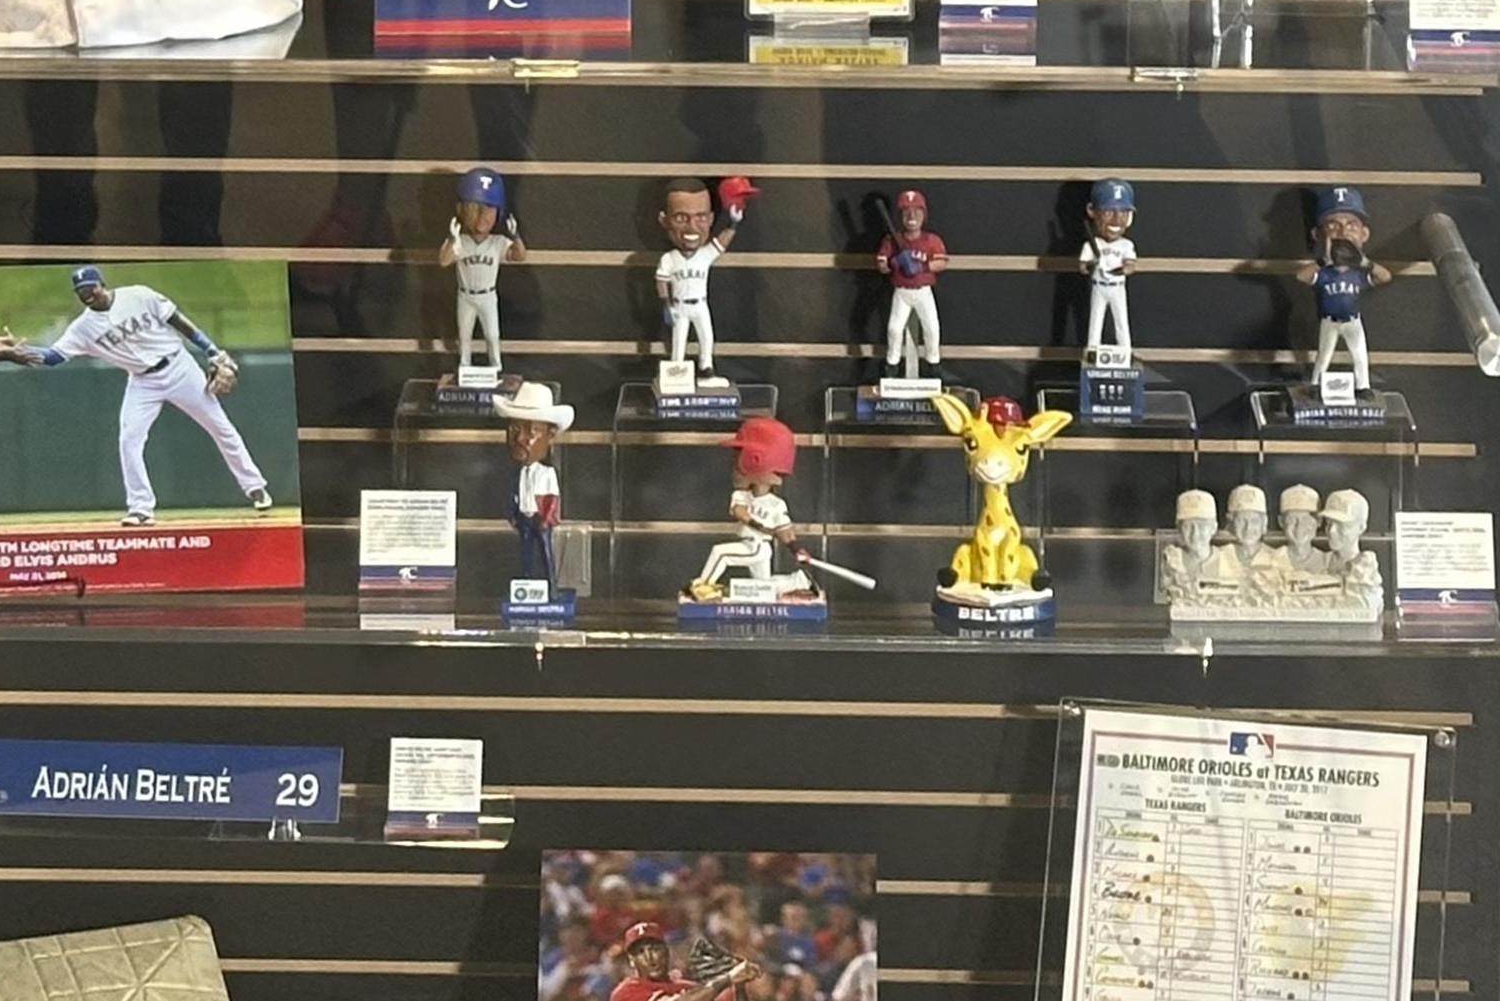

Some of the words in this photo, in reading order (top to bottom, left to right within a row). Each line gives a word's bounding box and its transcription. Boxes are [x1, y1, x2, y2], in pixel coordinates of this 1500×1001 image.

[1333, 188, 1348, 202] T
[21, 540, 94, 552] LONGTIME
[97, 537, 176, 550] TEAMMATE
[179, 536, 211, 548] AND
[14, 554, 54, 567] ELVIS
[56, 553, 118, 565] ANDRUS
[1122, 754, 1195, 774] BALTIMORE
[1199, 759, 1253, 778] ORIOLES
[1257, 766, 1270, 779] at
[1274, 764, 1314, 782] TEXAS
[1318, 768, 1380, 788] RANGERS
[31, 763, 129, 801] ADRIÁN
[135, 767, 232, 803] BELTRÉ
[275, 773, 320, 807] 29
[1145, 798, 1168, 810] TEXAS
[1170, 800, 1207, 813] RANGERS
[1285, 809, 1328, 823] BALTIMORE
[1330, 813, 1362, 825] ORIOLES
